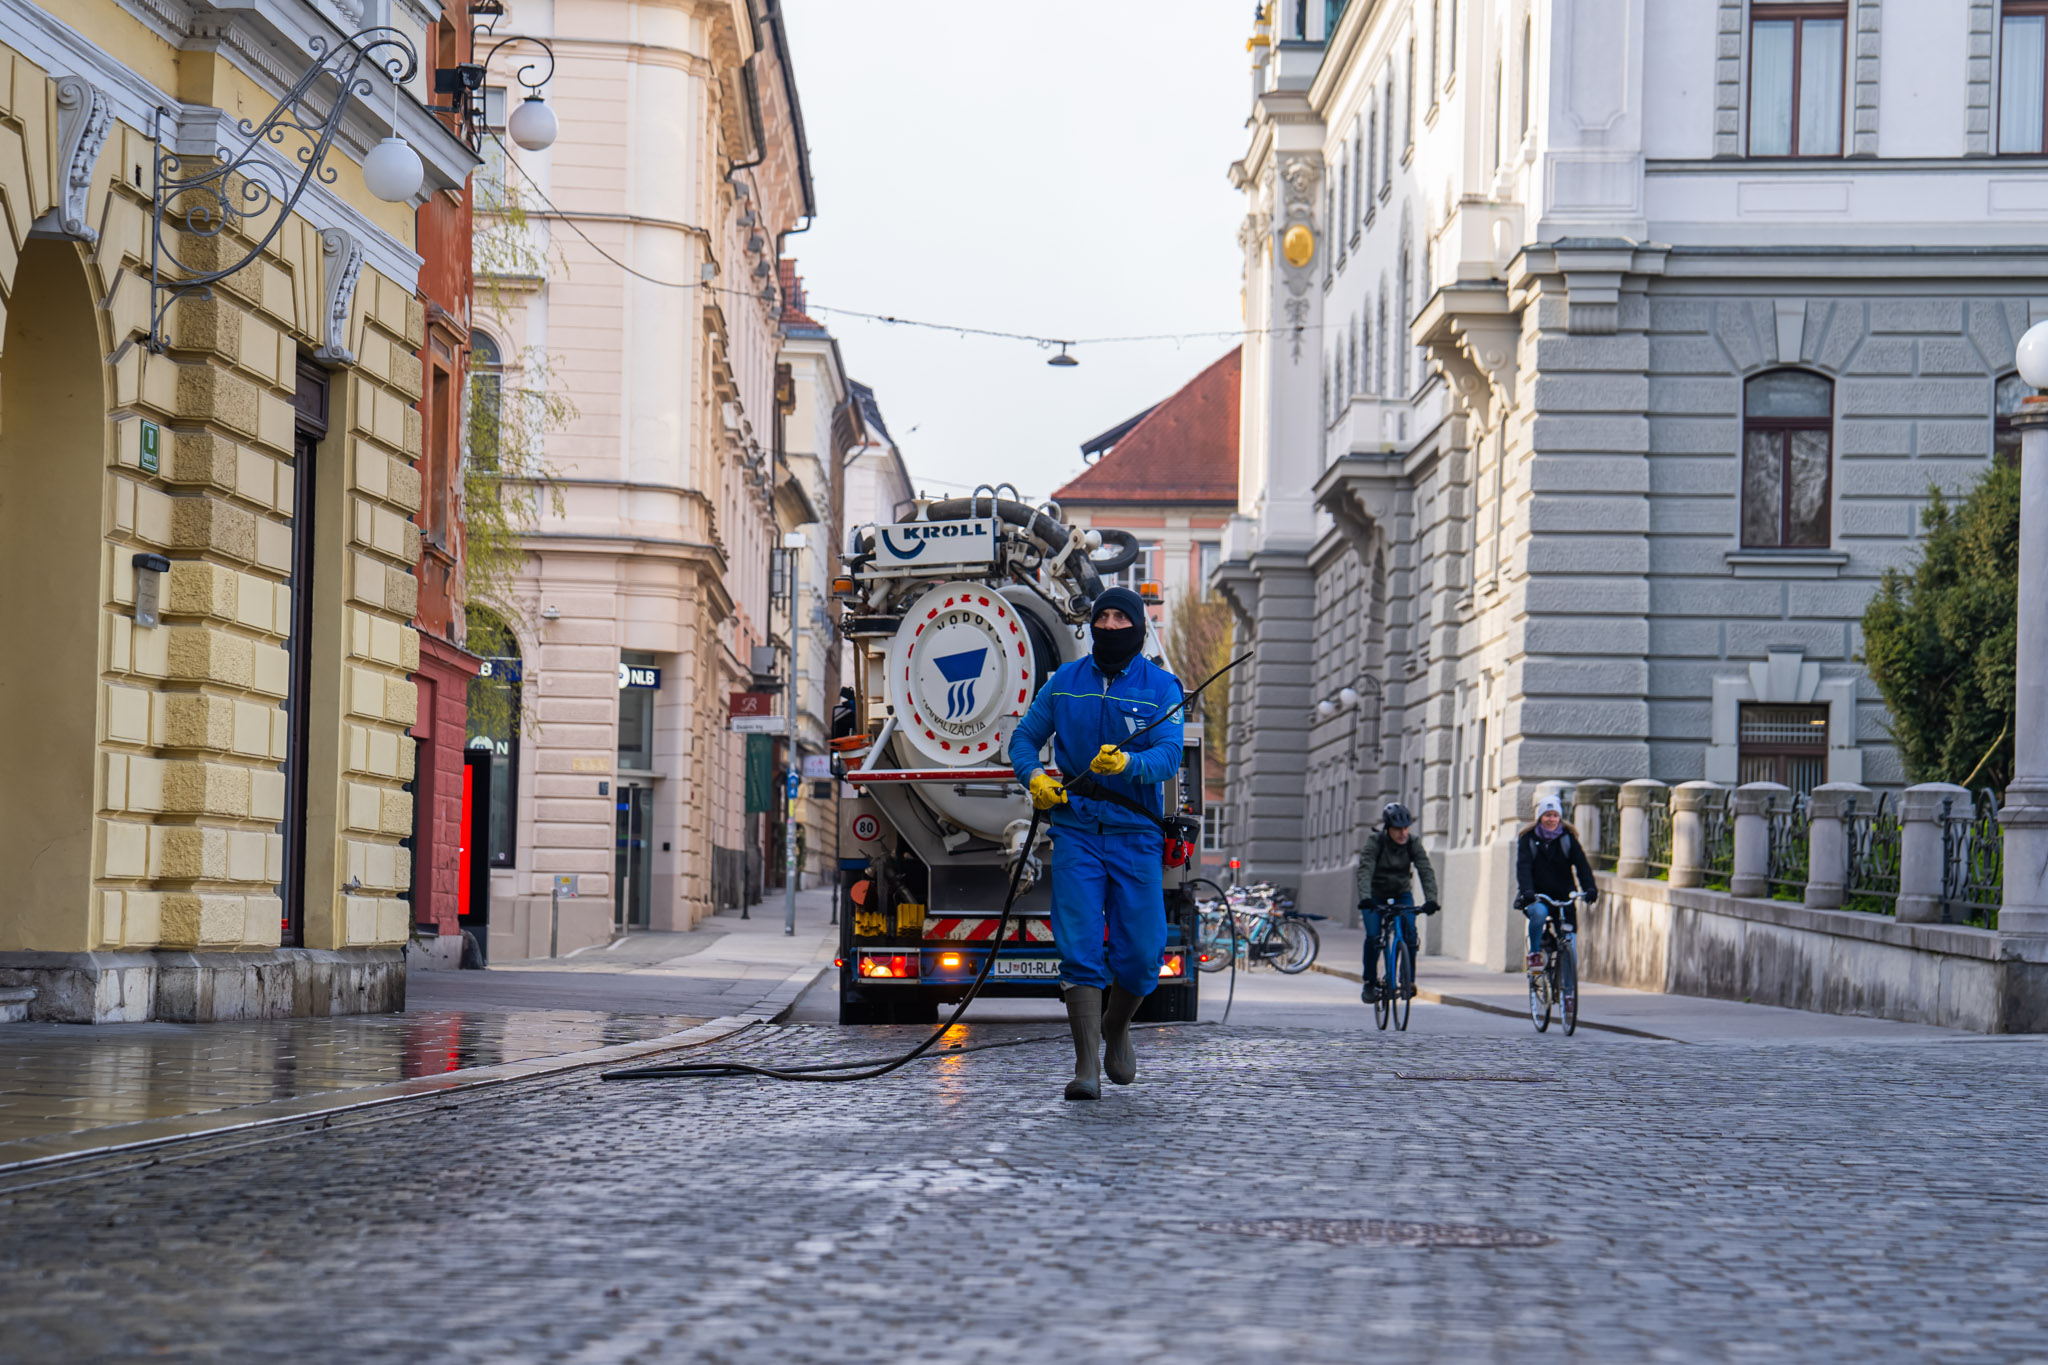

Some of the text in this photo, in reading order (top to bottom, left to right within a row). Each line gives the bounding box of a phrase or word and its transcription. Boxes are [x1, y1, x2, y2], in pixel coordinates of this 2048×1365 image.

[903, 523, 987, 540] KROLL
[630, 670, 656, 686] NLB
[859, 821, 874, 833] 80
[997, 962, 1059, 974] LJ 01-RLA
